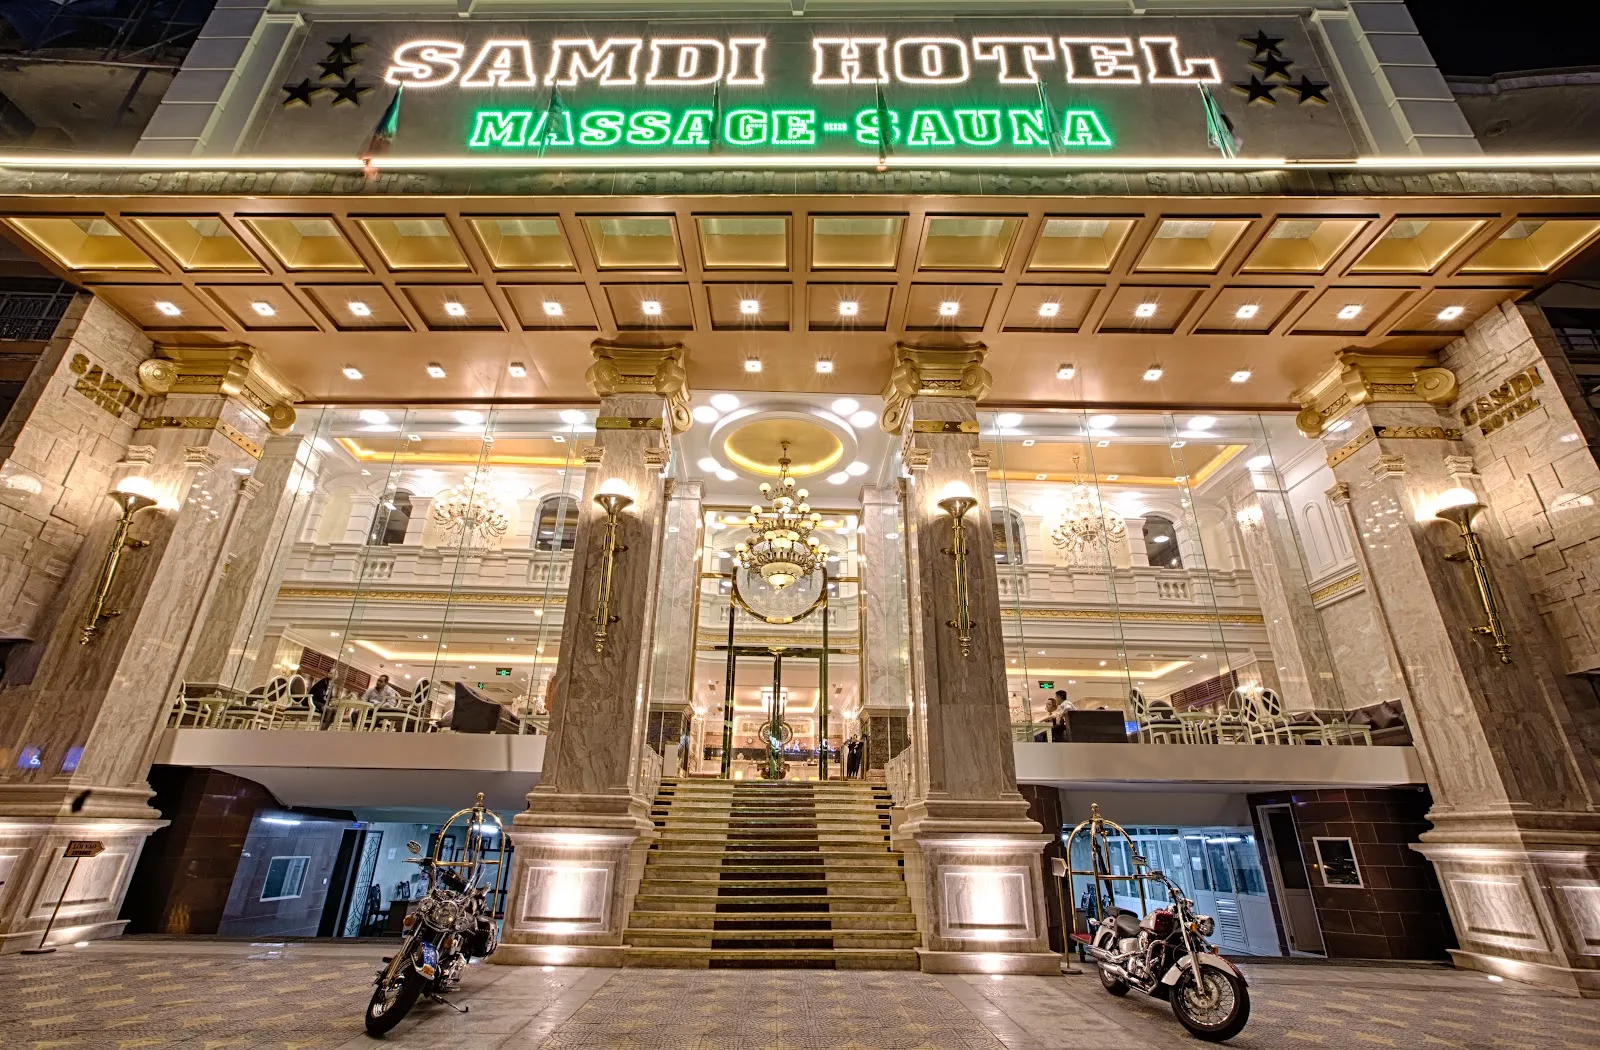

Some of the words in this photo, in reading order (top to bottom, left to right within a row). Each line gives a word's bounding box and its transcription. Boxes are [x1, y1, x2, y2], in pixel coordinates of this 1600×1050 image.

[385, 38, 767, 87] SAMDI
[811, 37, 1223, 87] HOTEL
[138, 171, 277, 193] SAMDI
[814, 171, 961, 192] HOTEL
[1328, 171, 1485, 193] HOTEL
[1460, 366, 1544, 426] SAMDI
[1479, 396, 1540, 435] HOTEL
